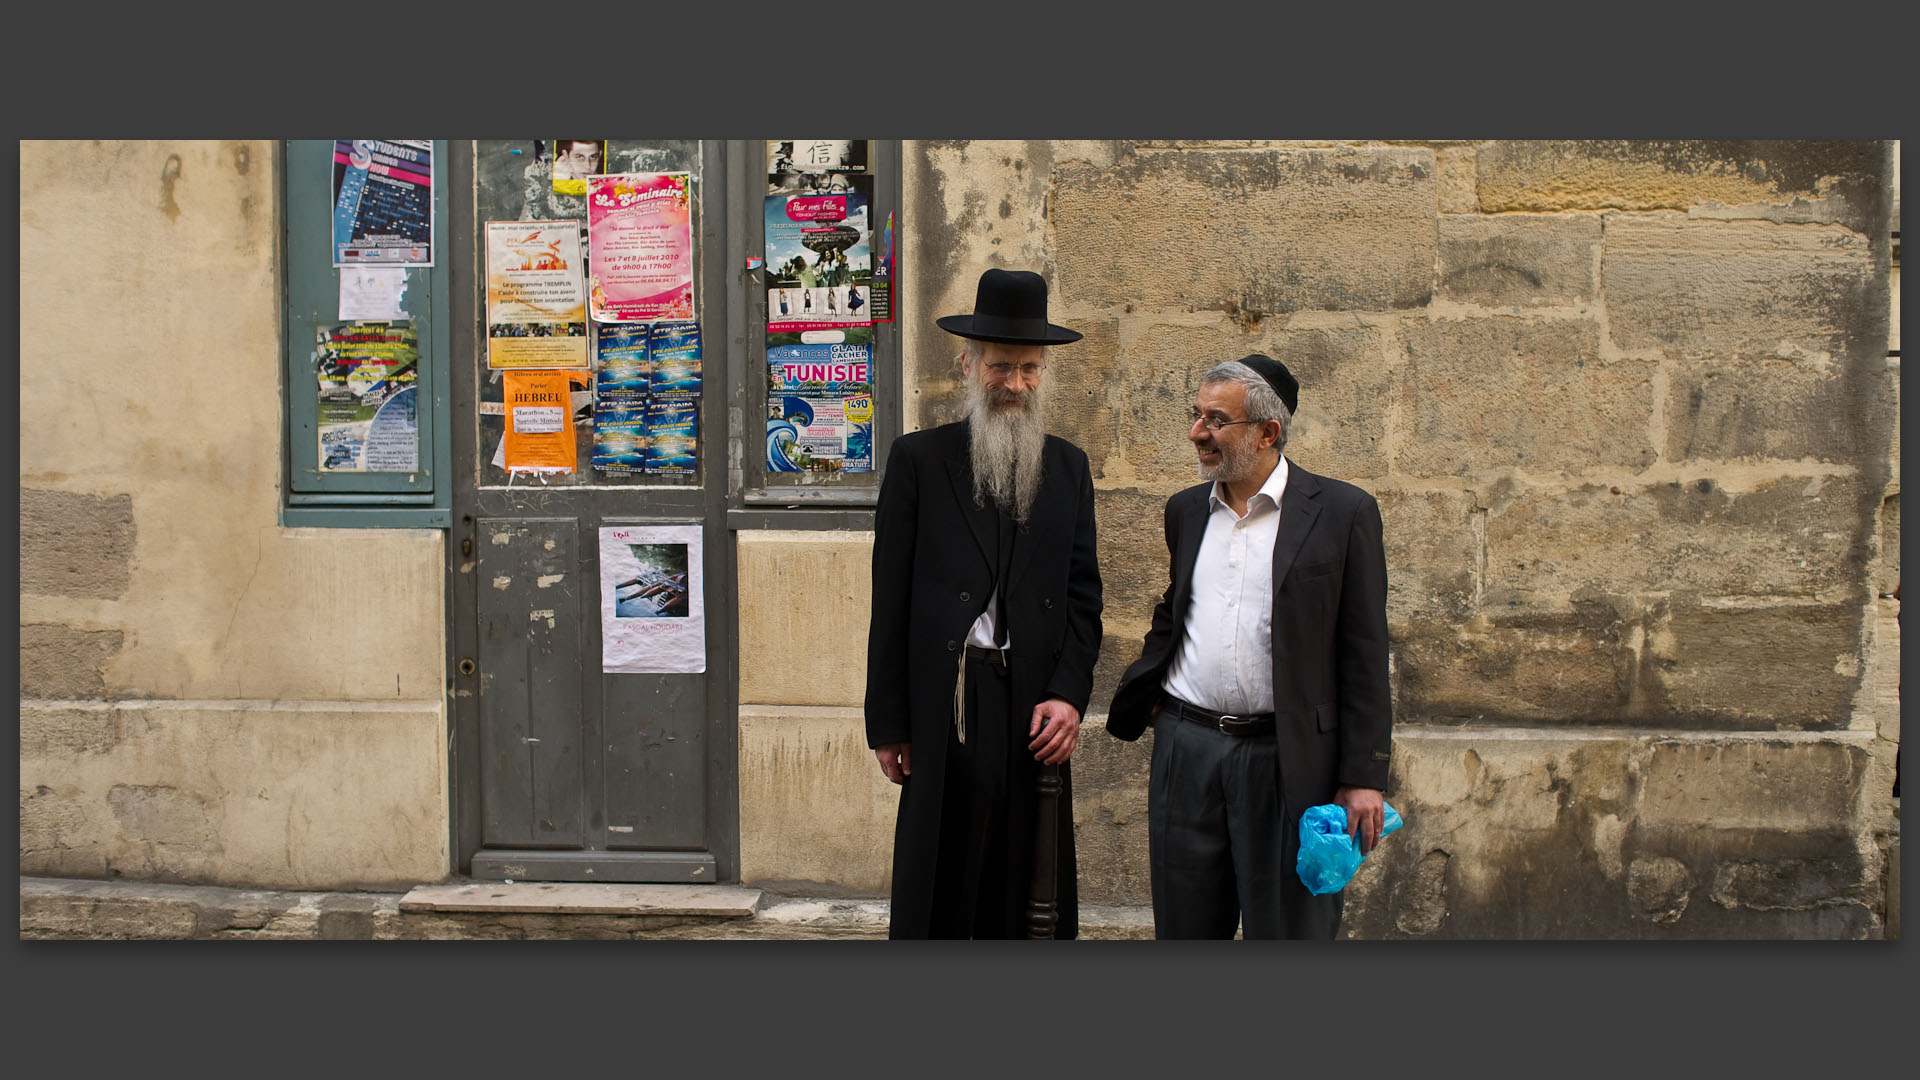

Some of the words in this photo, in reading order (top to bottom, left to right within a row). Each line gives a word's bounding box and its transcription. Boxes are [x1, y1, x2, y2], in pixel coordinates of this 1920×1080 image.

[807, 142, 833, 164] 信
[595, 194, 615, 207] Le
[618, 185, 684, 207] Séminaire
[792, 202, 807, 211] Pour
[822, 200, 837, 210] Filles
[604, 255, 616, 263] Les
[637, 254, 659, 263] juillet
[622, 263, 641, 271] 9h00
[648, 262, 672, 270] 17h00
[775, 347, 829, 358] Vacances
[831, 345, 867, 353] GLATT
[783, 365, 867, 382] TUNISIE
[514, 392, 563, 402] HEBREU
[623, 623, 649, 632] PASCAL
